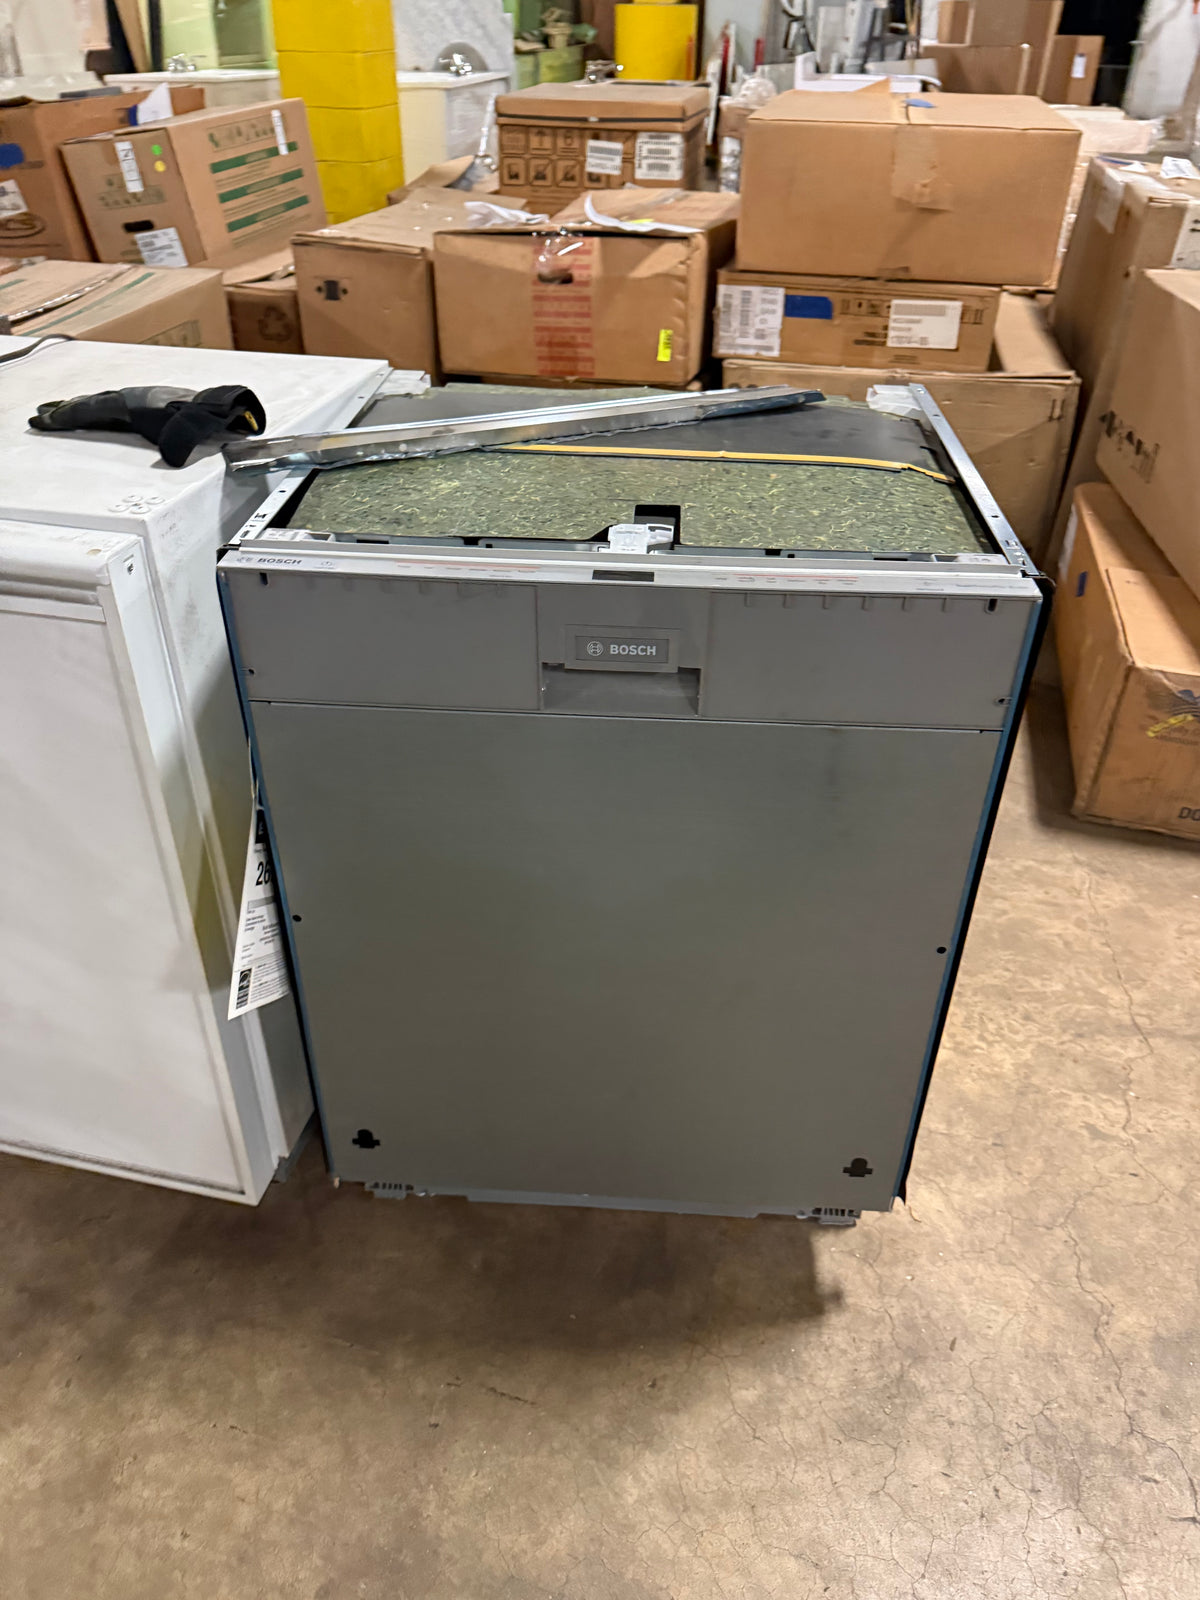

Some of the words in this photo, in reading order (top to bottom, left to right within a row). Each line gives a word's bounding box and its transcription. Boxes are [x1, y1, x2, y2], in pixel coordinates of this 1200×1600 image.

[257, 557, 302, 565] BOSCH
[609, 644, 656, 656] BOSCH
[255, 861, 273, 886] 26
